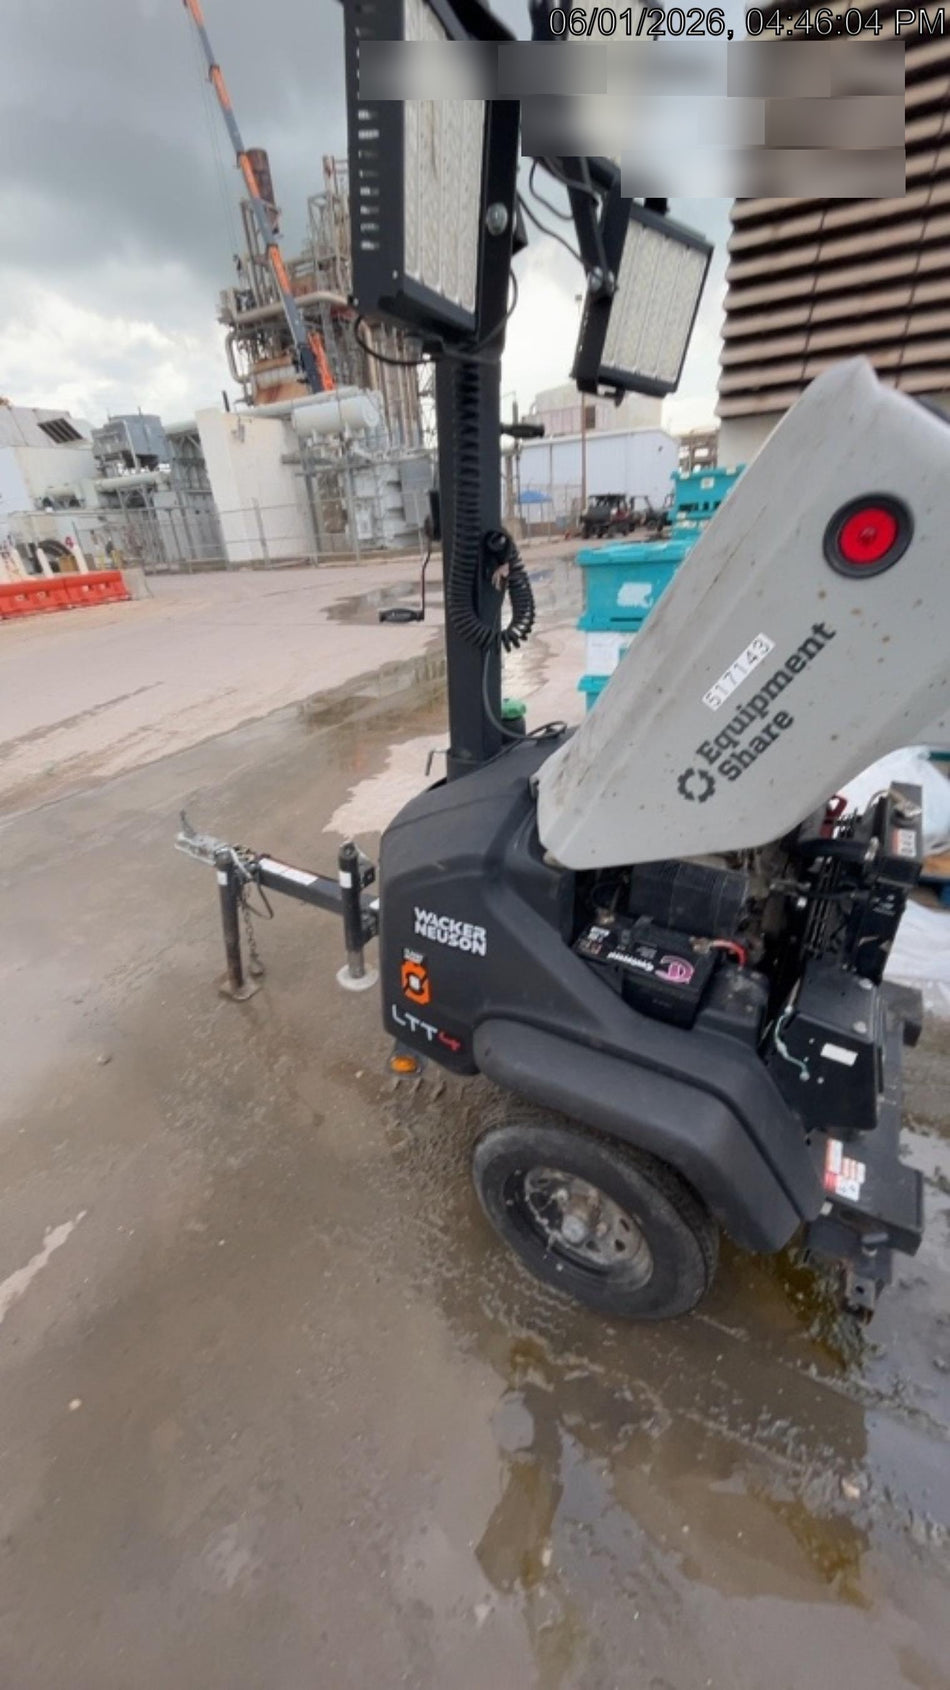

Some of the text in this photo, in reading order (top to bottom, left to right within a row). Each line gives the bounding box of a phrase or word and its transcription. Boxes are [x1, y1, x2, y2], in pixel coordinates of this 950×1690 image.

[695, 621, 837, 766] Equipment
[705, 639, 770, 707] 517143
[717, 709, 795, 782] Share
[414, 906, 487, 941] WACKER
[414, 920, 487, 957] NEUSON
